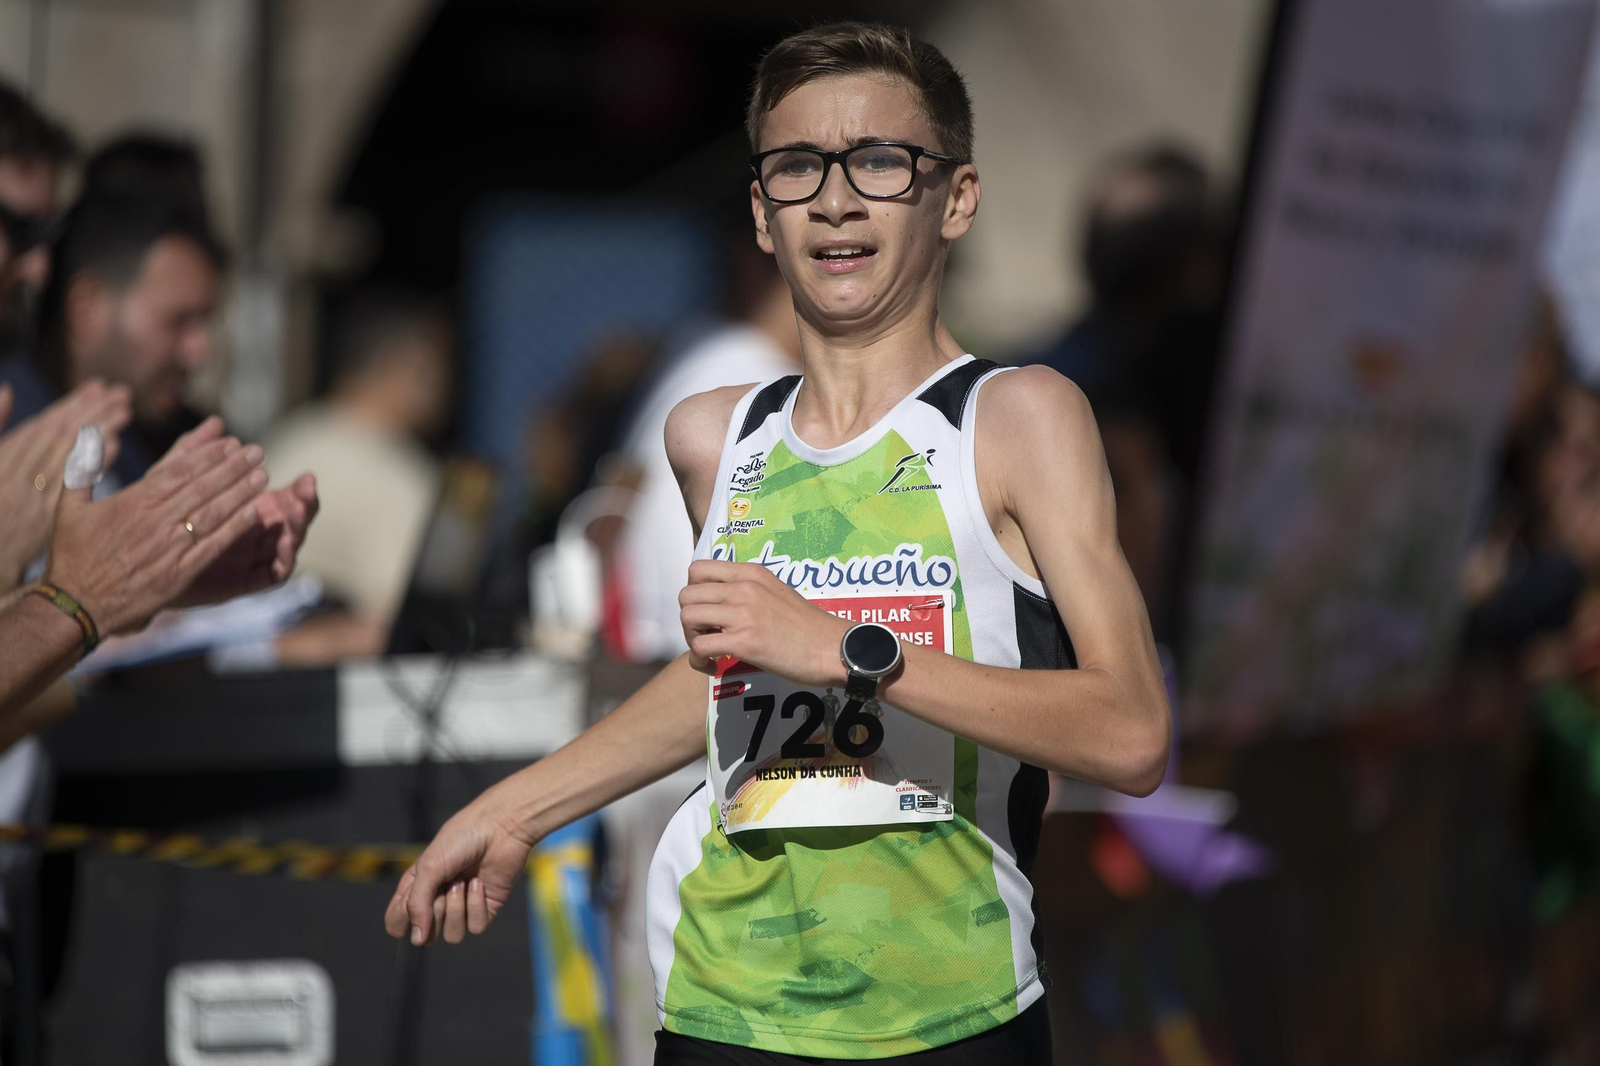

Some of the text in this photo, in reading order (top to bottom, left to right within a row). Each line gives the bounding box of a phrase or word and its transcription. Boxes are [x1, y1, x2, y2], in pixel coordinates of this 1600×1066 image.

[731, 472, 764, 488] Legado
[734, 519, 764, 528] DENTAL
[861, 608, 911, 623] PILAR
[743, 691, 884, 763] 726
[756, 764, 861, 781] NELSON DA CUNHA
